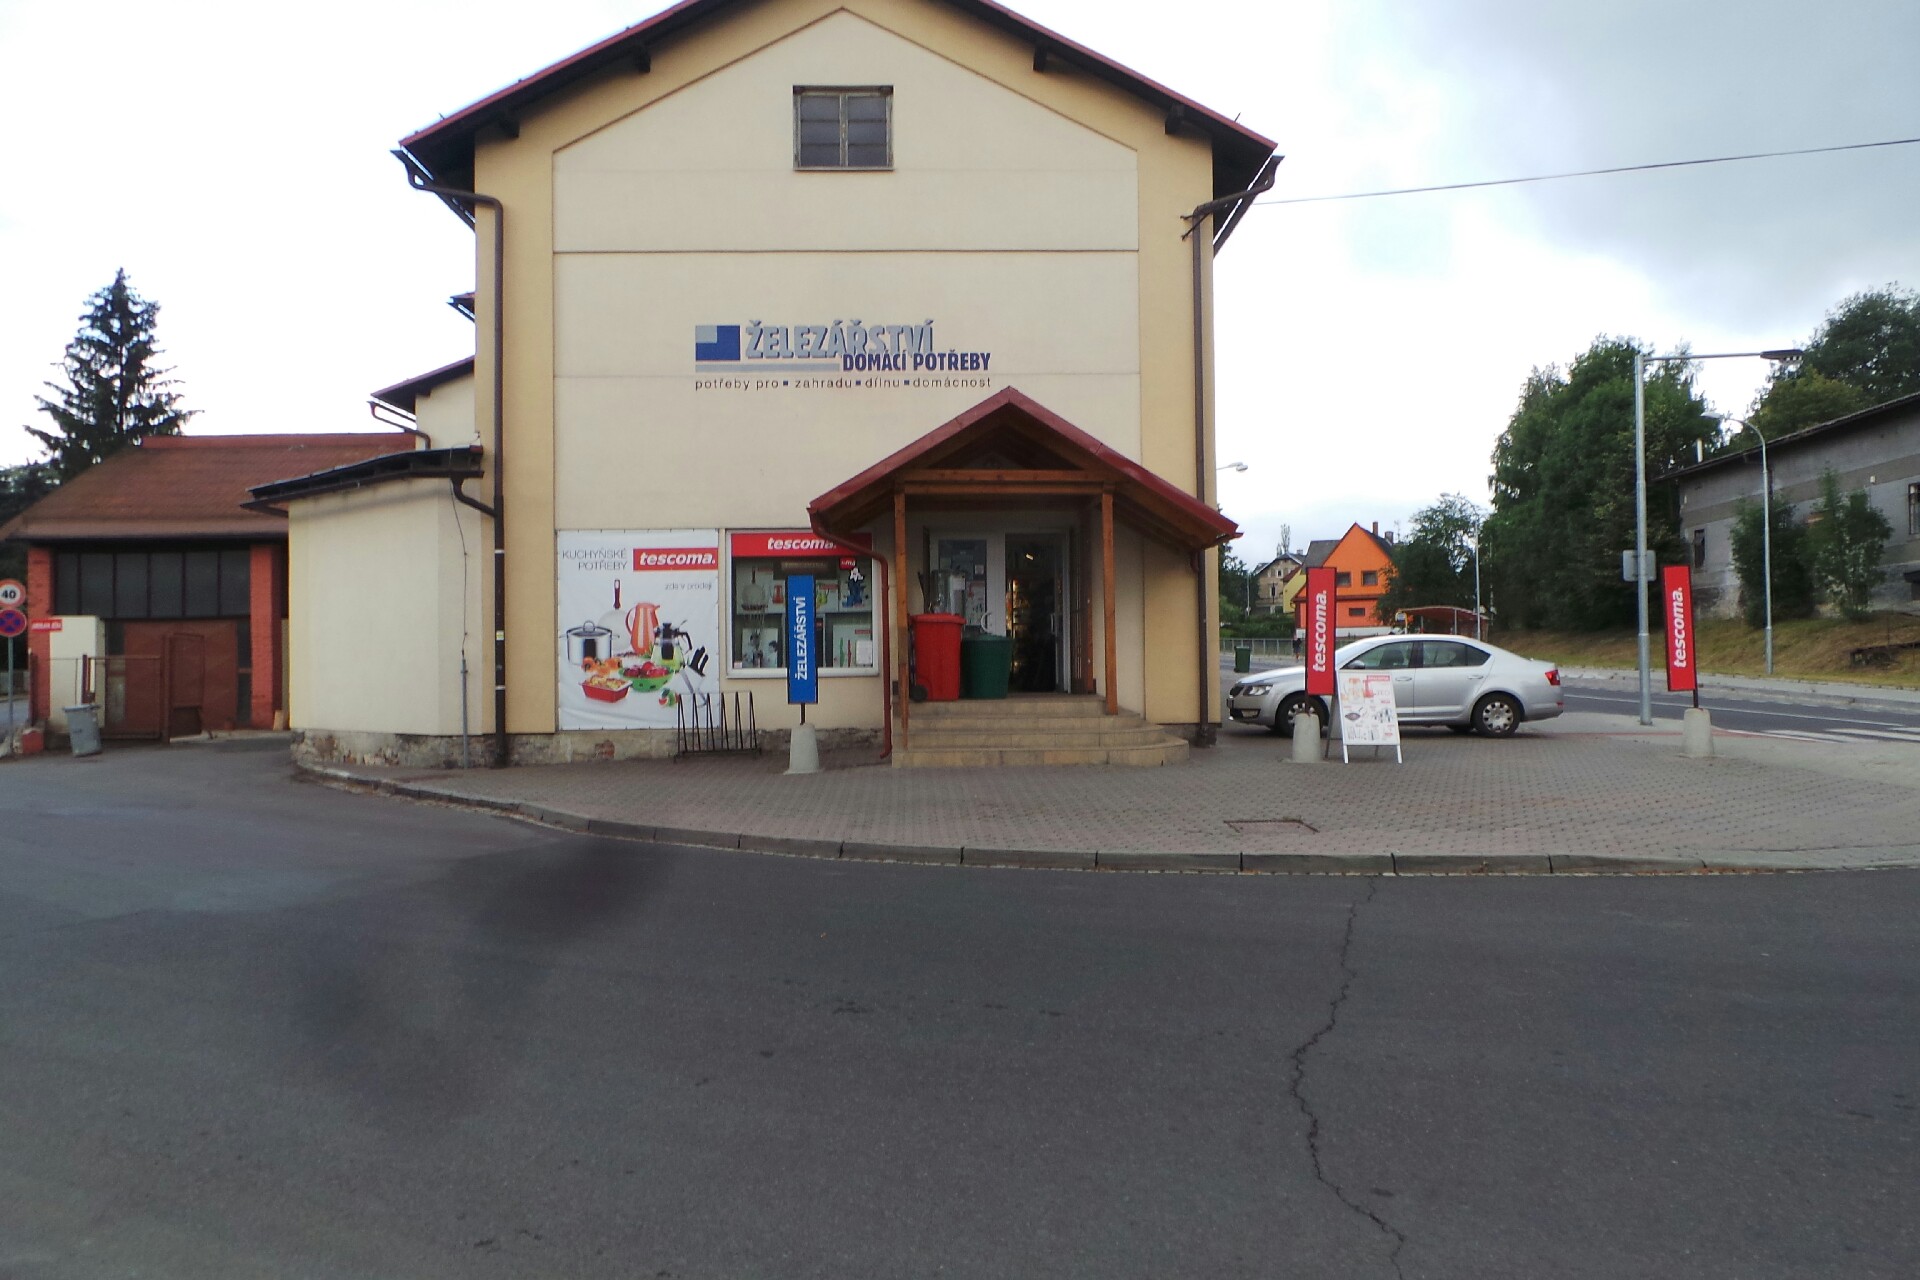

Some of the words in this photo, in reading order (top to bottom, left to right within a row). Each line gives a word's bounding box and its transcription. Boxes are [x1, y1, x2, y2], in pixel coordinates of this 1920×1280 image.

[745, 319, 934, 359] ŽELEZÁŘSTVÍ
[842, 350, 907, 371] DOMÁCÍ
[913, 349, 991, 371] POTŘEBY
[695, 377, 750, 391] potřeby
[756, 380, 779, 390] pro
[795, 377, 852, 389] zahradu
[865, 376, 899, 388] dílnu
[913, 376, 991, 388] domácnost
[562, 548, 627, 560] KUCHYŇSKÉ
[578, 560, 628, 571] POTŘEBY
[2, 590, 17, 599] 40
[794, 596, 808, 681] ŽELEZÁŘSTVÍ
